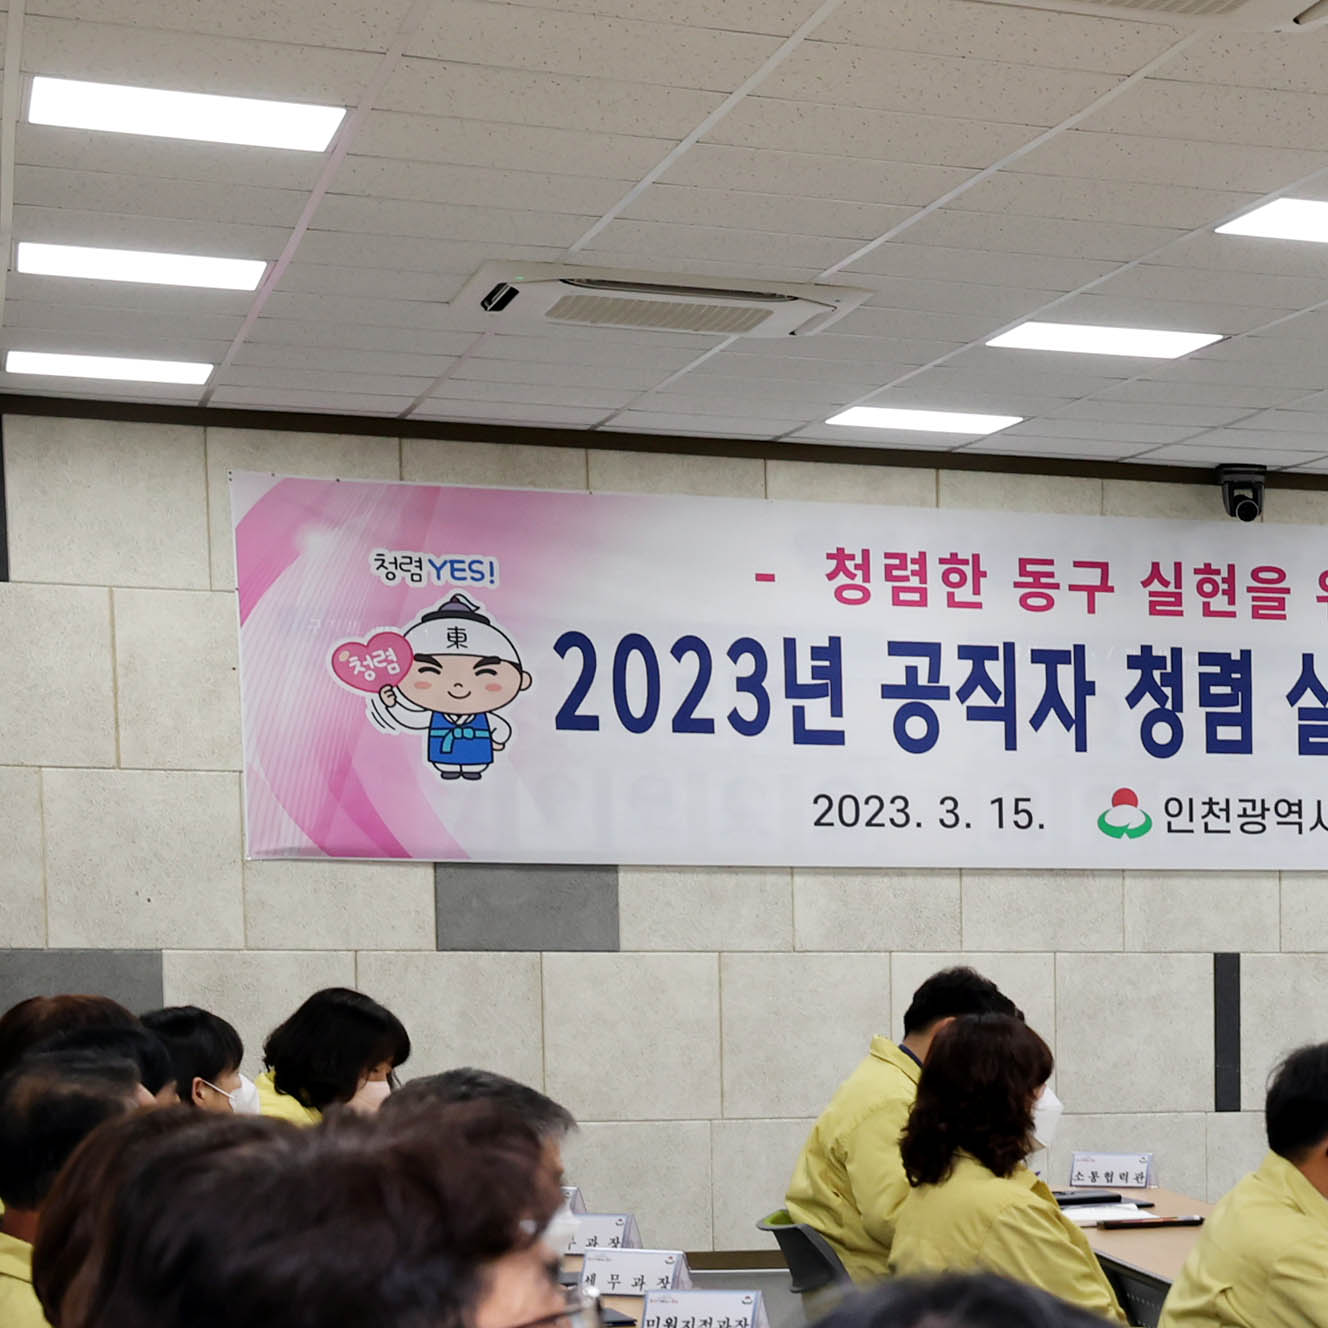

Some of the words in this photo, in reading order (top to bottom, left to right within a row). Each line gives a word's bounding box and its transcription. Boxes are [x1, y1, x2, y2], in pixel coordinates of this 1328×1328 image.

[373, 553, 423, 583] 청렴
[427, 558, 495, 585] YES!
[825, 546, 988, 610] 청렴한
[1013, 557, 1115, 615] 동구
[1140, 561, 1291, 621] 실현을
[446, 626, 468, 649] 東
[348, 647, 401, 681] 청렴
[552, 630, 846, 746] 2023년
[880, 640, 1097, 755] 공직자
[1124, 644, 1253, 759] 청렴
[812, 793, 922, 828] 2023.
[938, 796, 971, 829] 3.
[990, 797, 1045, 830] 15.
